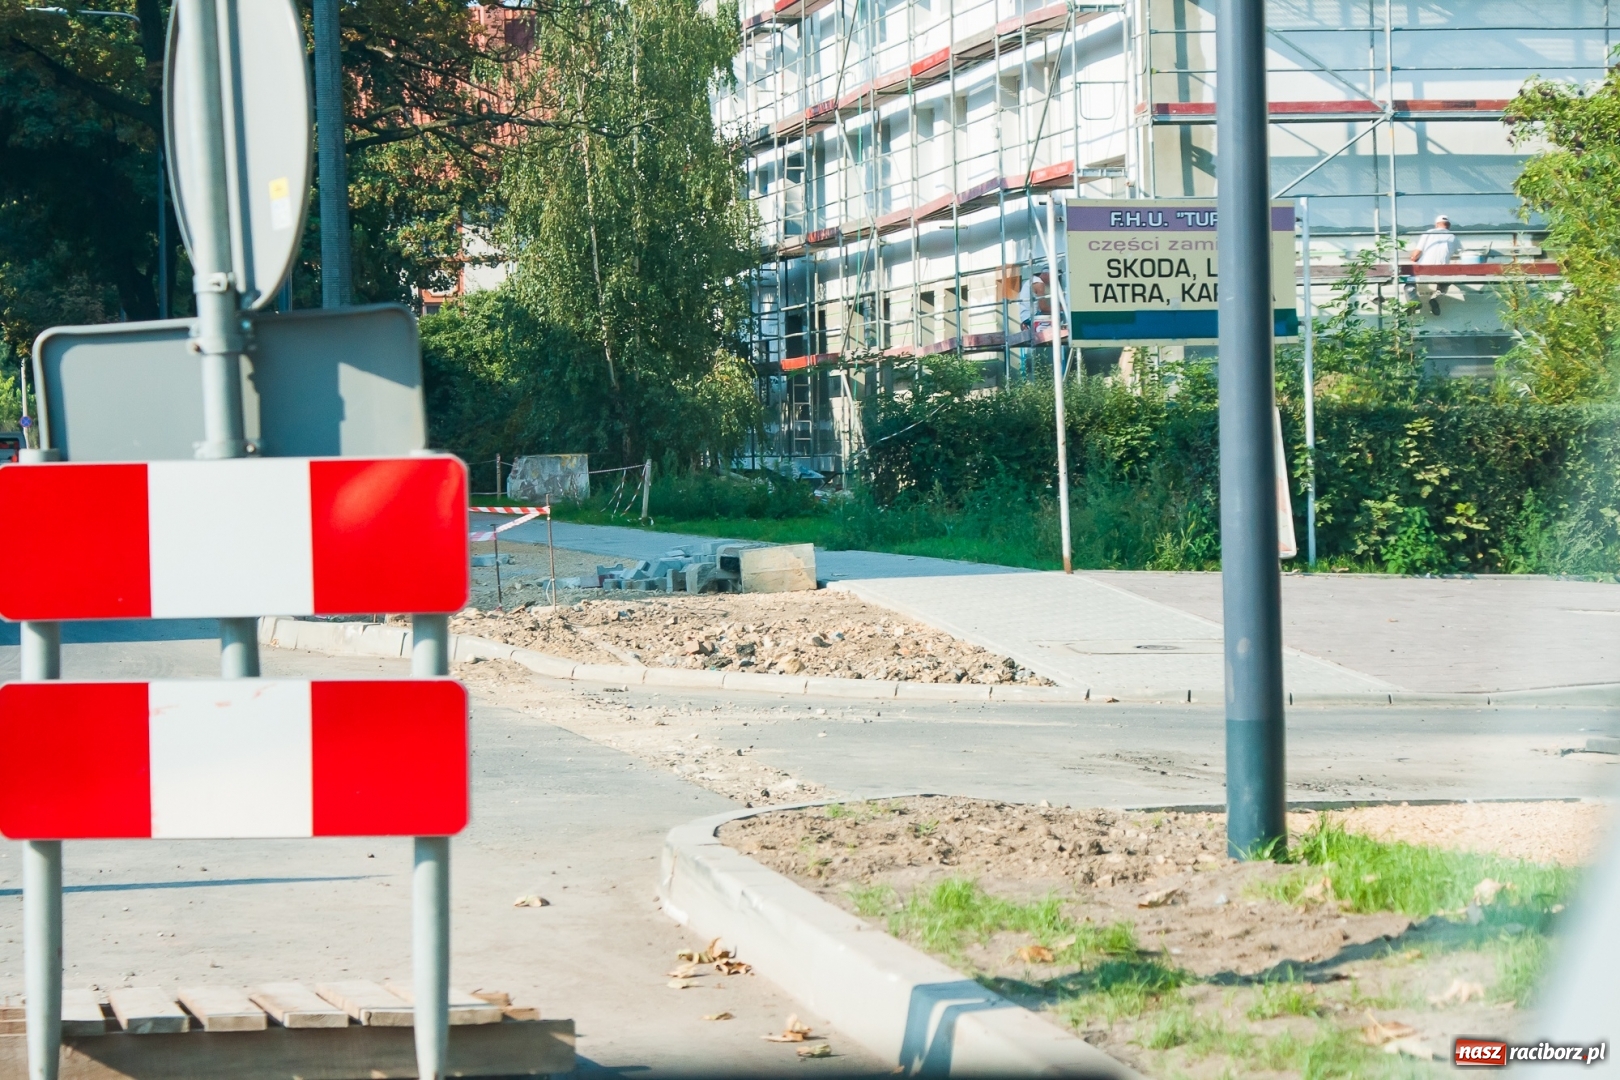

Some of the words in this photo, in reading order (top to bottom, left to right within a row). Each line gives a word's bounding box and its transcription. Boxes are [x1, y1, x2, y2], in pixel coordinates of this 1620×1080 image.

[1110, 211, 1169, 227] F.H.U.
[1088, 237, 1160, 254] części
[1106, 258, 1197, 281] SKODA,
[1089, 284, 1171, 306] TATRA,
